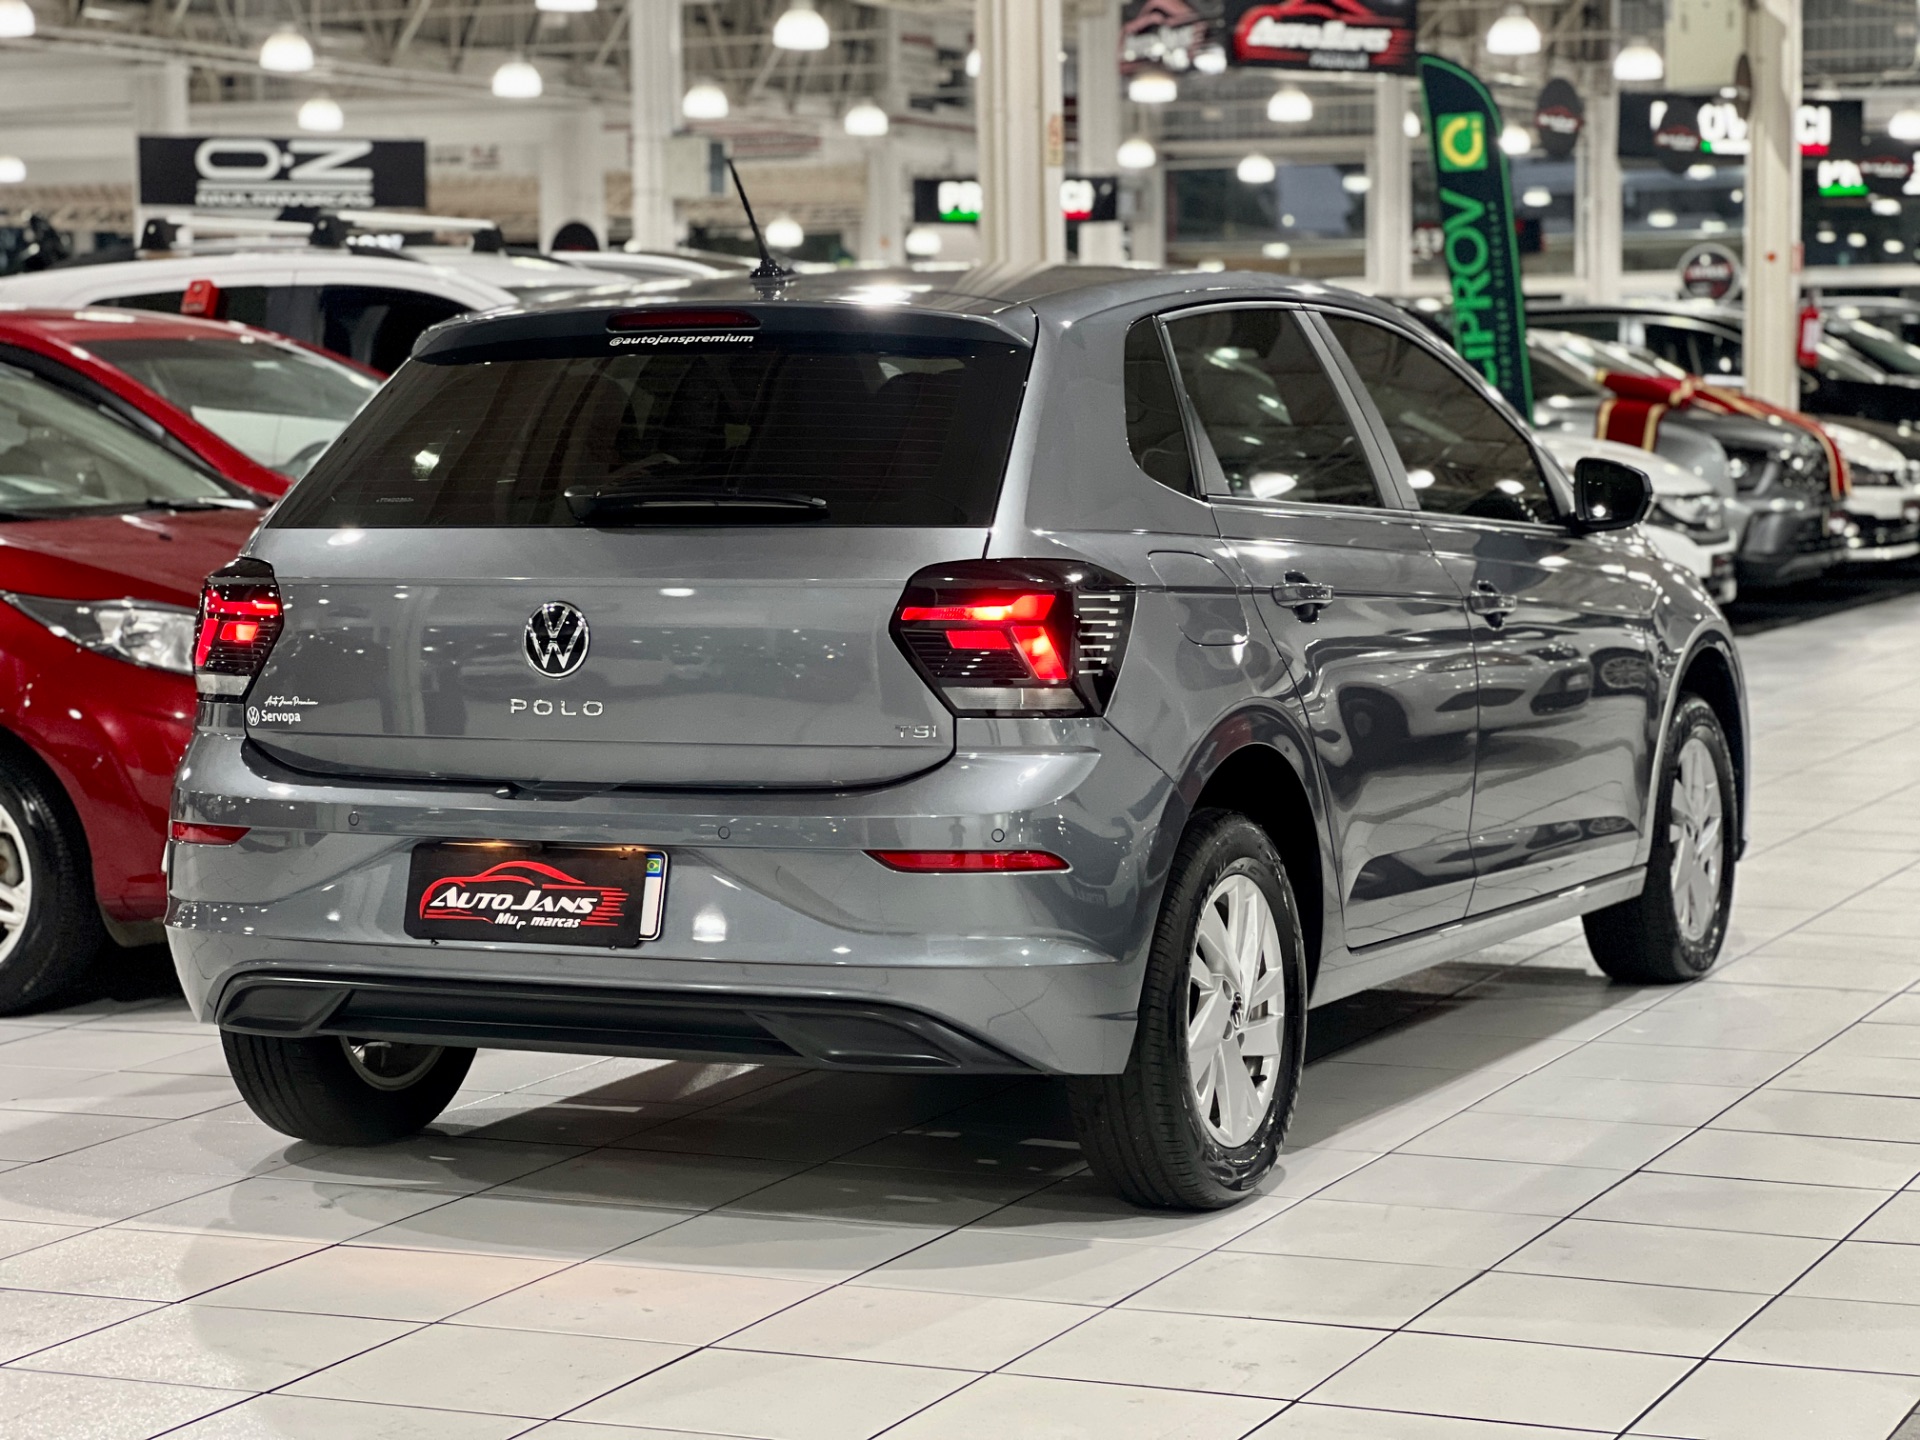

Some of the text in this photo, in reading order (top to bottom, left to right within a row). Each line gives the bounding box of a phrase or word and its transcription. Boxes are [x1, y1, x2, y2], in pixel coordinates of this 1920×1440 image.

[609, 334, 754, 346] @autojanspremium
[510, 698, 604, 716] POLO
[261, 709, 302, 725] Servopa
[895, 725, 937, 738] TSI
